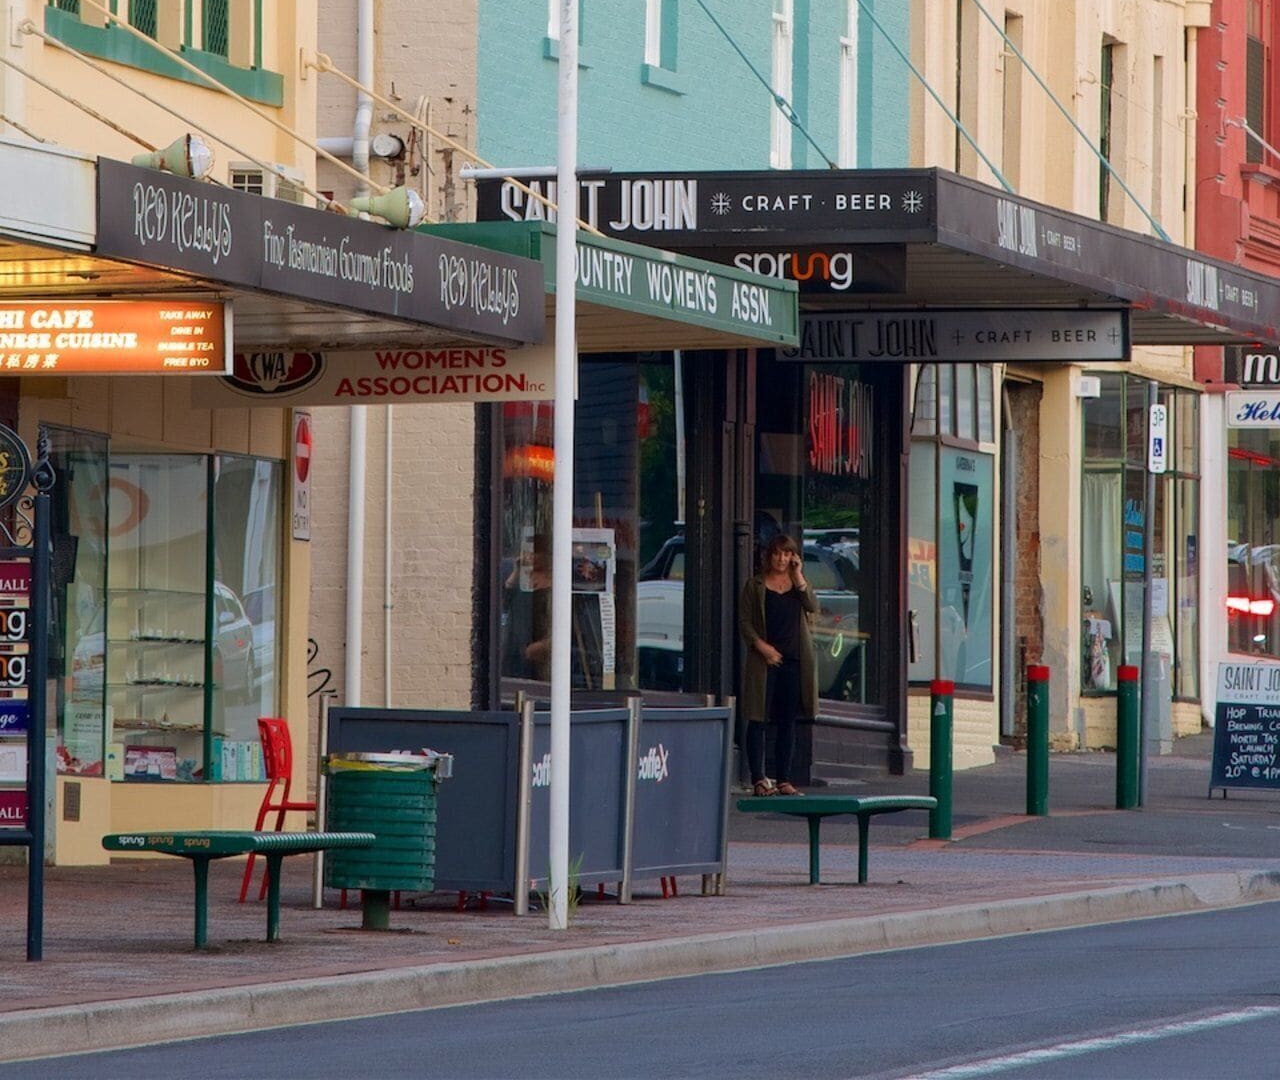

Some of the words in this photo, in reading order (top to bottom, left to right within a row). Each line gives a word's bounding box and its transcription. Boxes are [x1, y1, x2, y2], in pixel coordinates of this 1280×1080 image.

[133, 181, 168, 246] RED
[609, 179, 697, 231] JOHN
[741, 195, 813, 212] CRAFT
[835, 194, 892, 211] BEER
[286, 223, 338, 276] Tasmanian
[339, 235, 382, 292] Gourmet
[382, 244, 414, 294] Foods
[439, 253, 469, 311] RED
[646, 260, 717, 314] WOMEN'S
[30, 309, 95, 329] CAFE
[159, 310, 183, 320] TAKE
[184, 310, 213, 320] AWAY
[54, 332, 138, 349] CUISINE
[196, 342, 214, 351] TEA
[974, 330, 1033, 344] CRAFT
[1050, 329, 1098, 342] BEER
[189, 357, 209, 366] BYO
[375, 348, 507, 370] WOMEN'S
[334, 373, 525, 397] ASSOCIATION
[525, 380, 546, 392] Inc
[1224, 666, 1262, 691] SAINT
